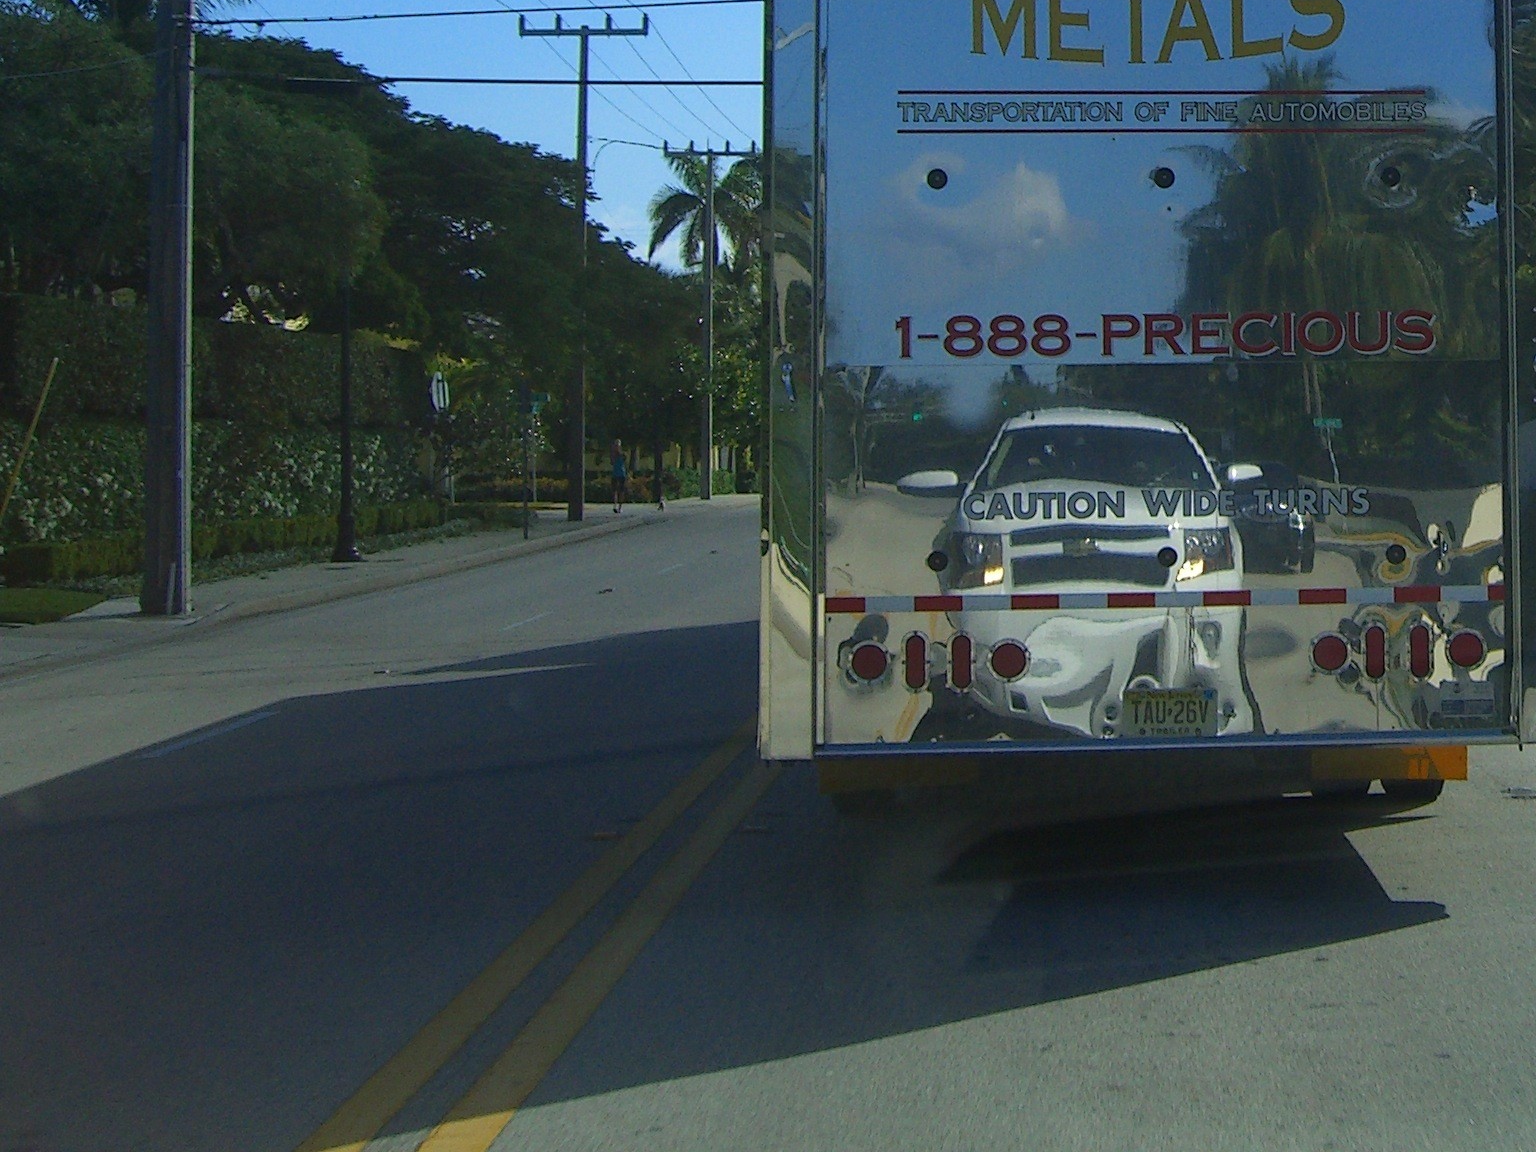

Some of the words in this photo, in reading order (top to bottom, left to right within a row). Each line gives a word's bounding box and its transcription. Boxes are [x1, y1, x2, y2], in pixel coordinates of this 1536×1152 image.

[897, 101, 1123, 123] TRANSPORTATION
[1134, 101, 1170, 122] OF
[1180, 101, 1238, 122] FINE
[1250, 101, 1427, 122] AUTOMOBILES
[895, 308, 1437, 359] 1-888-PRECIOUS
[962, 490, 1126, 521] CAUTION
[1141, 489, 1236, 518] WIDE
[1253, 486, 1371, 517] TURNS
